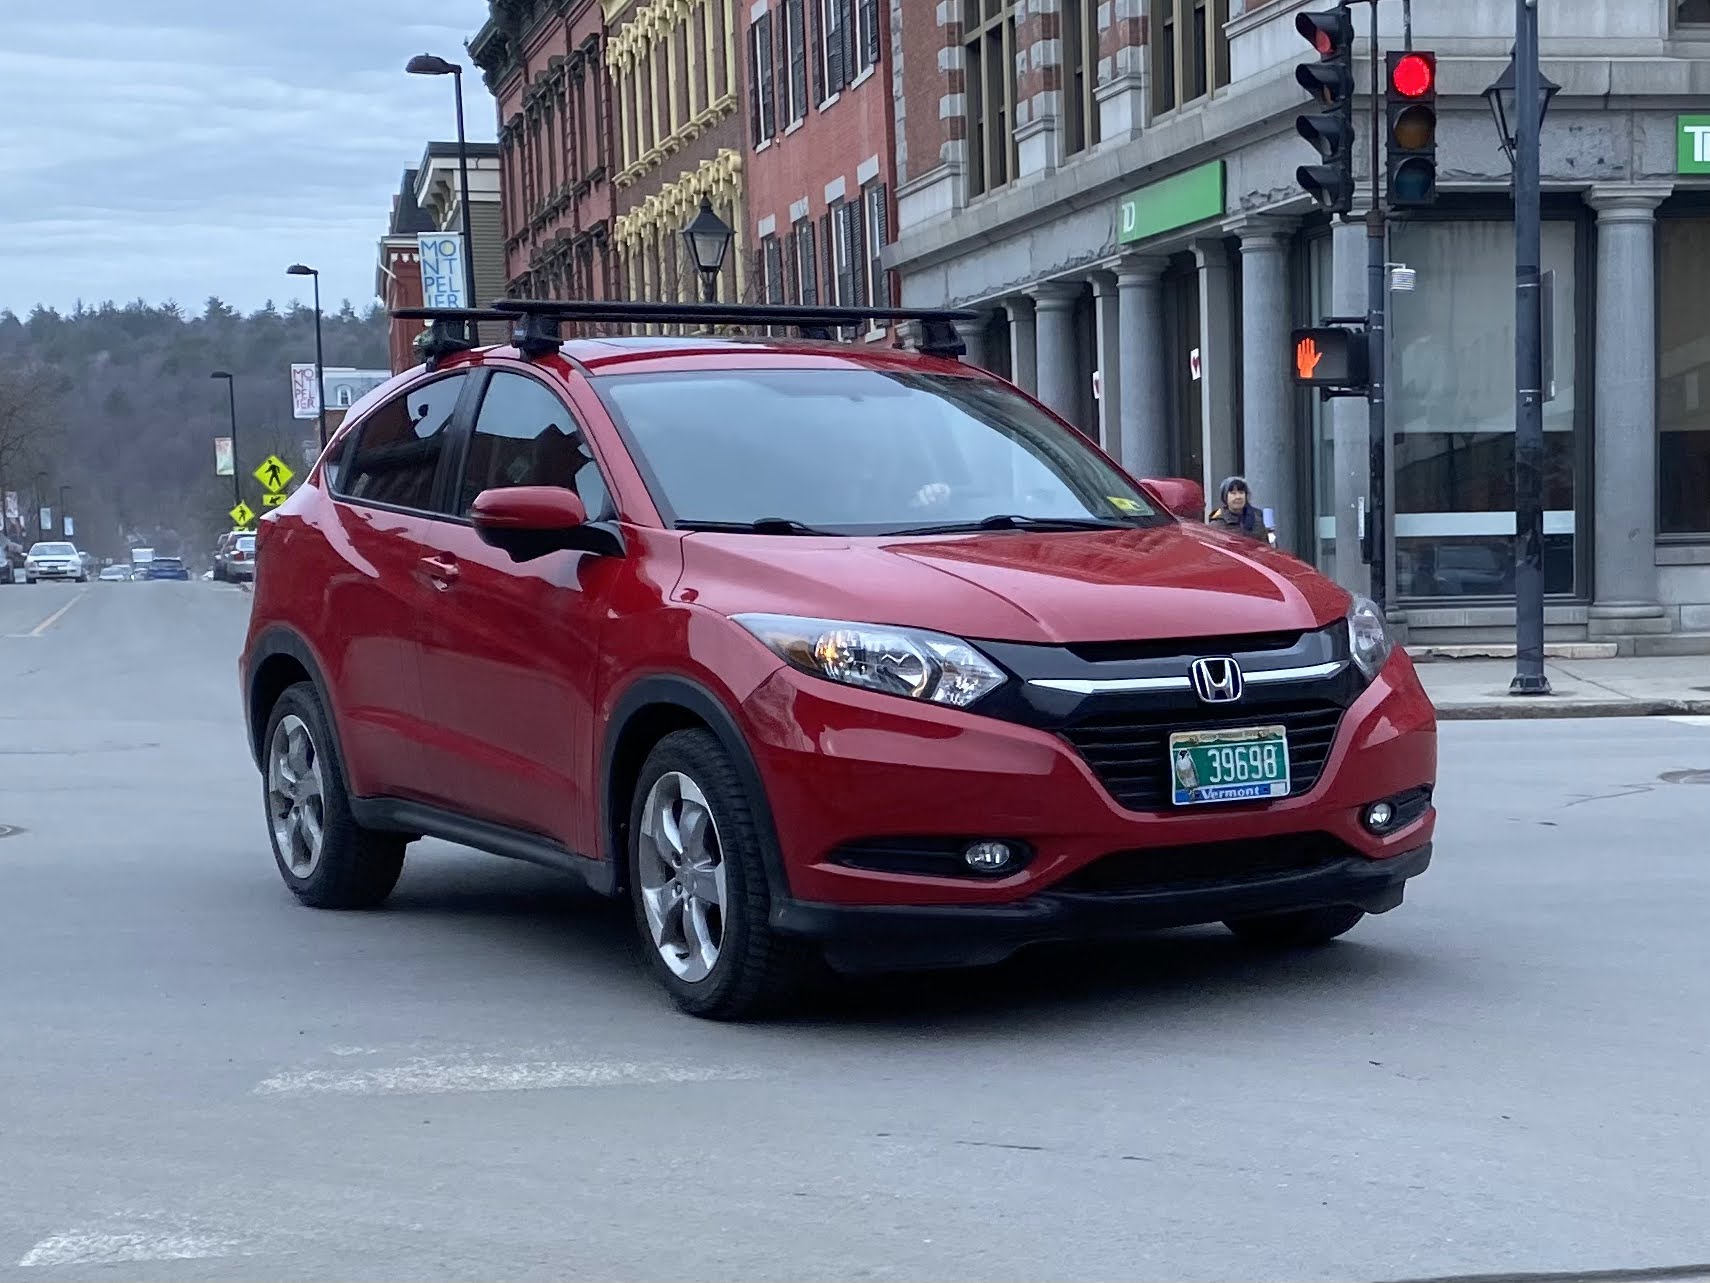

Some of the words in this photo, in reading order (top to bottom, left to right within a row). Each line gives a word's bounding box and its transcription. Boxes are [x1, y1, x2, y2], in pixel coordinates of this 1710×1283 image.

[1122, 201, 1136, 233] TD
[420, 239, 457, 257] MO
[422, 258, 458, 275] NT
[424, 276, 461, 293] PEL
[293, 368, 314, 379] MO
[296, 399, 315, 409] IER
[1207, 744, 1278, 784] 39698
[1199, 785, 1261, 800] Vermont
